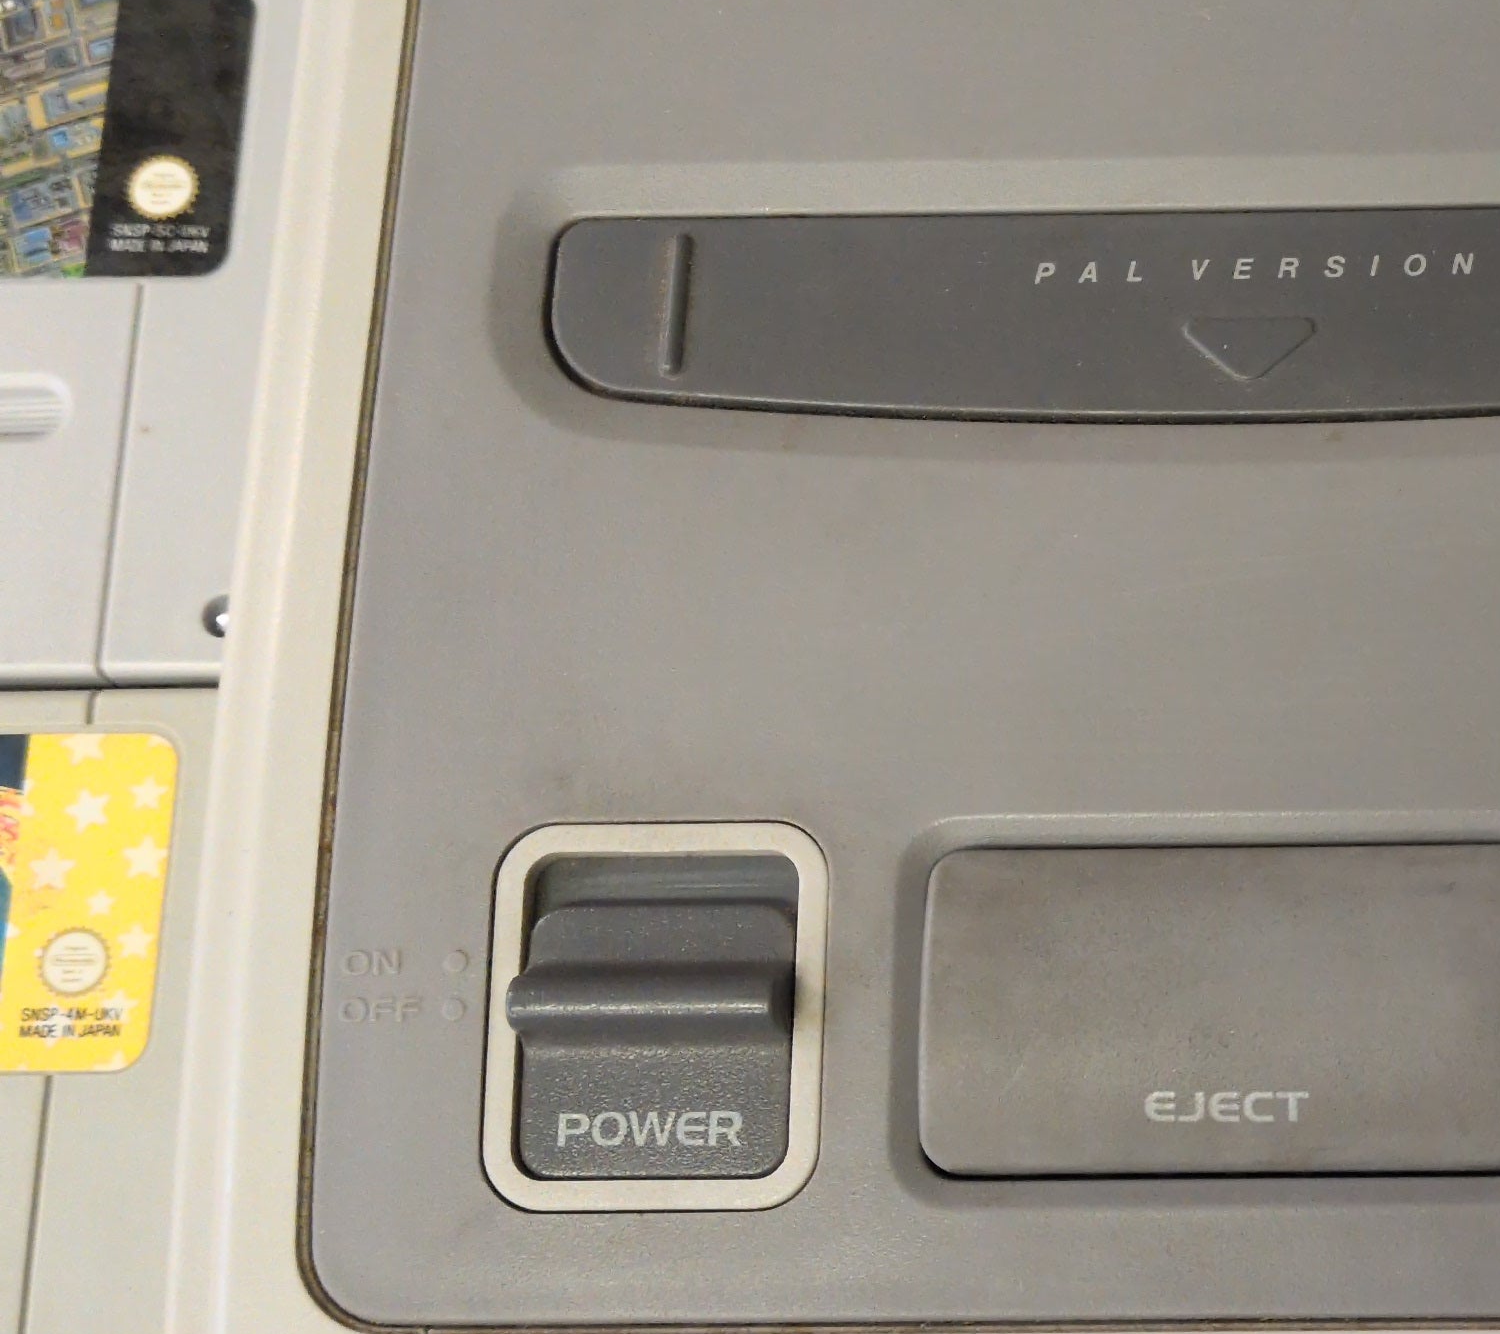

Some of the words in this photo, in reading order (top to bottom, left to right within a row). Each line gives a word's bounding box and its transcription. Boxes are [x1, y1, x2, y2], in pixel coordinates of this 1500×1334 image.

[110, 239, 146, 252] MADE
[149, 238, 165, 252] IN
[168, 239, 208, 253] JAPAN
[1034, 260, 1143, 285] PAL
[1191, 252, 1475, 282] VERSION
[341, 948, 402, 977] ON
[338, 995, 422, 1025] OFF
[19, 1023, 57, 1038] MADE
[61, 1024, 75, 1037] IN
[78, 1023, 121, 1038] JAPAN
[1144, 1090, 1310, 1123] EJECT
[557, 1110, 744, 1148] POWER
